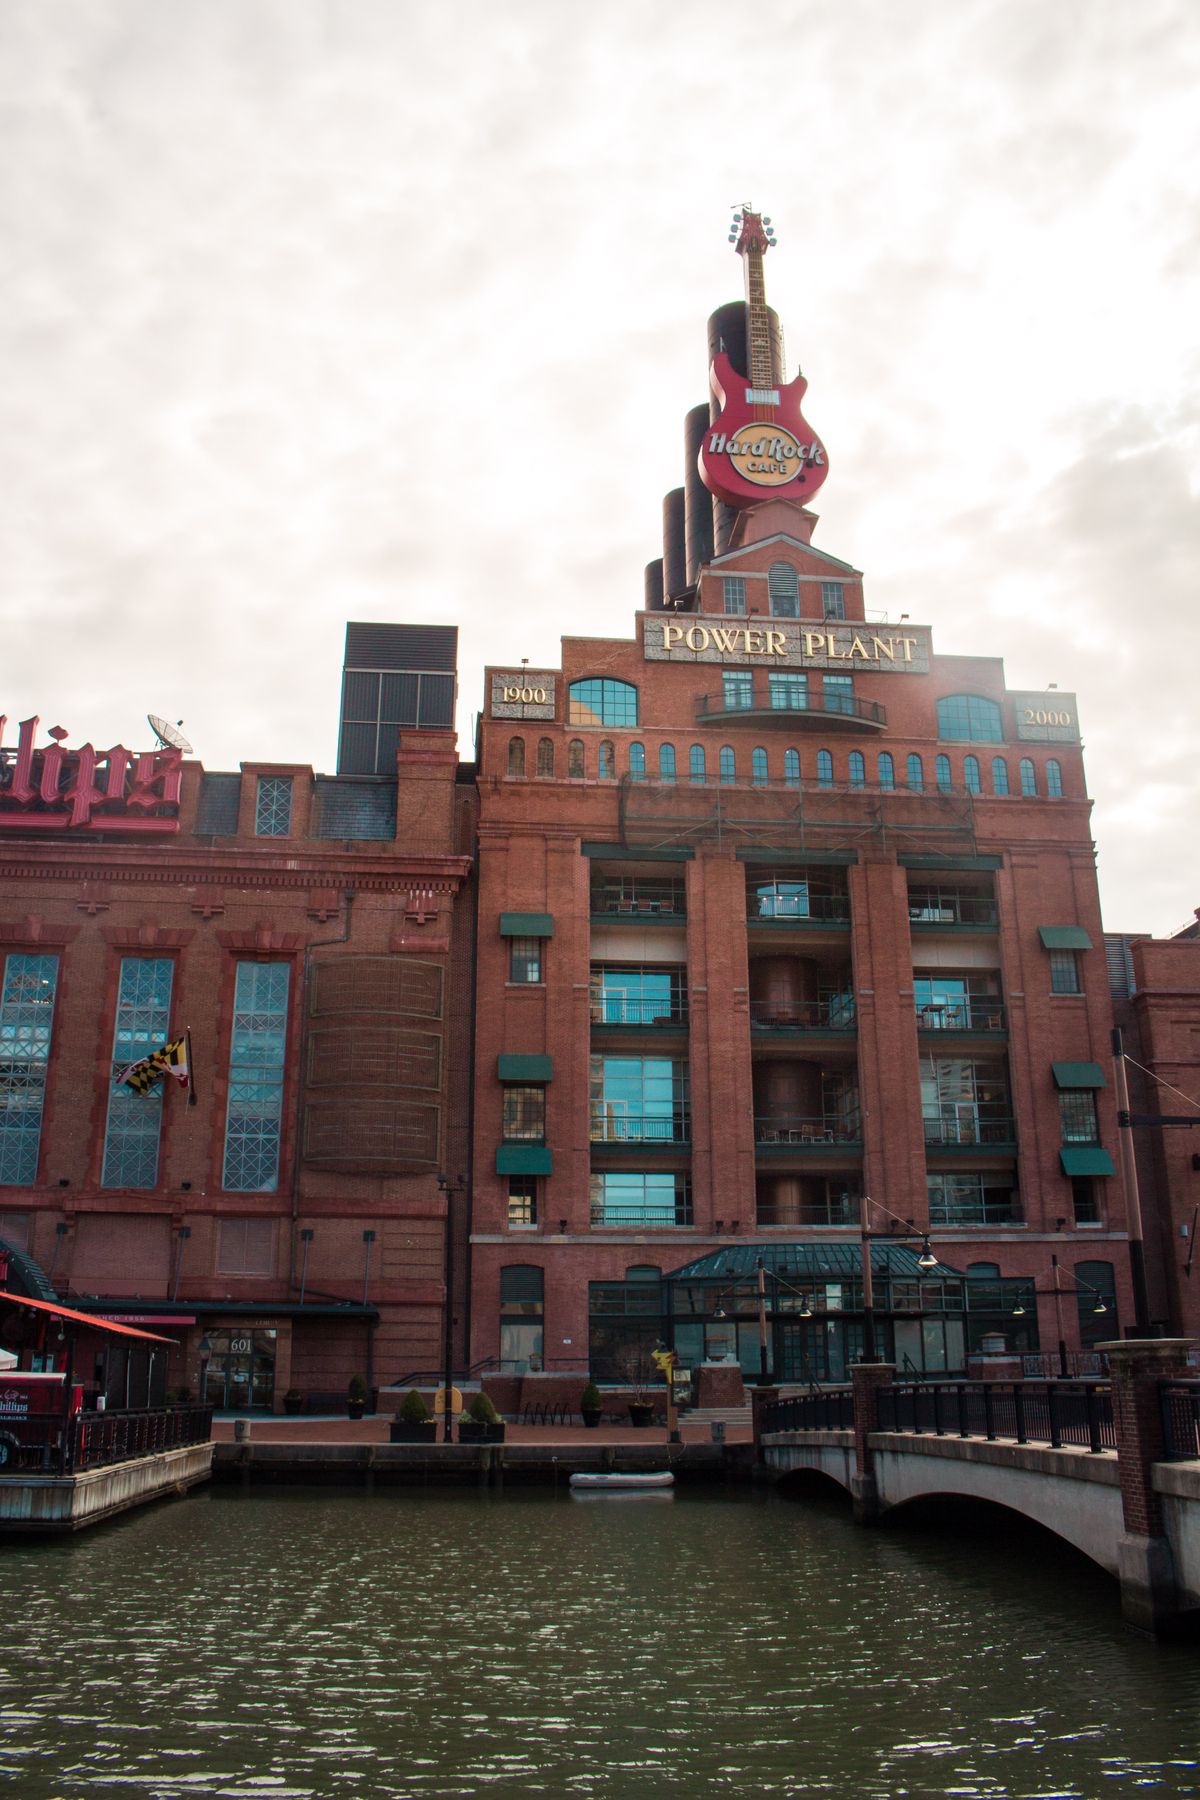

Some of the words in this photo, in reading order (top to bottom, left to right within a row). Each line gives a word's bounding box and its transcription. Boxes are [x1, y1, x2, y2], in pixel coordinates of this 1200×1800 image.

[708, 432, 767, 456] Hard
[768, 436, 825, 465] Rock
[747, 461, 788, 475] CAFE
[661, 625, 789, 657] POWER
[803, 631, 917, 663] PLANT
[503, 686, 546, 704] 1900
[1024, 709, 1071, 727] 2000
[0, 714, 183, 828] lips
[231, 1338, 251, 1351] 601
